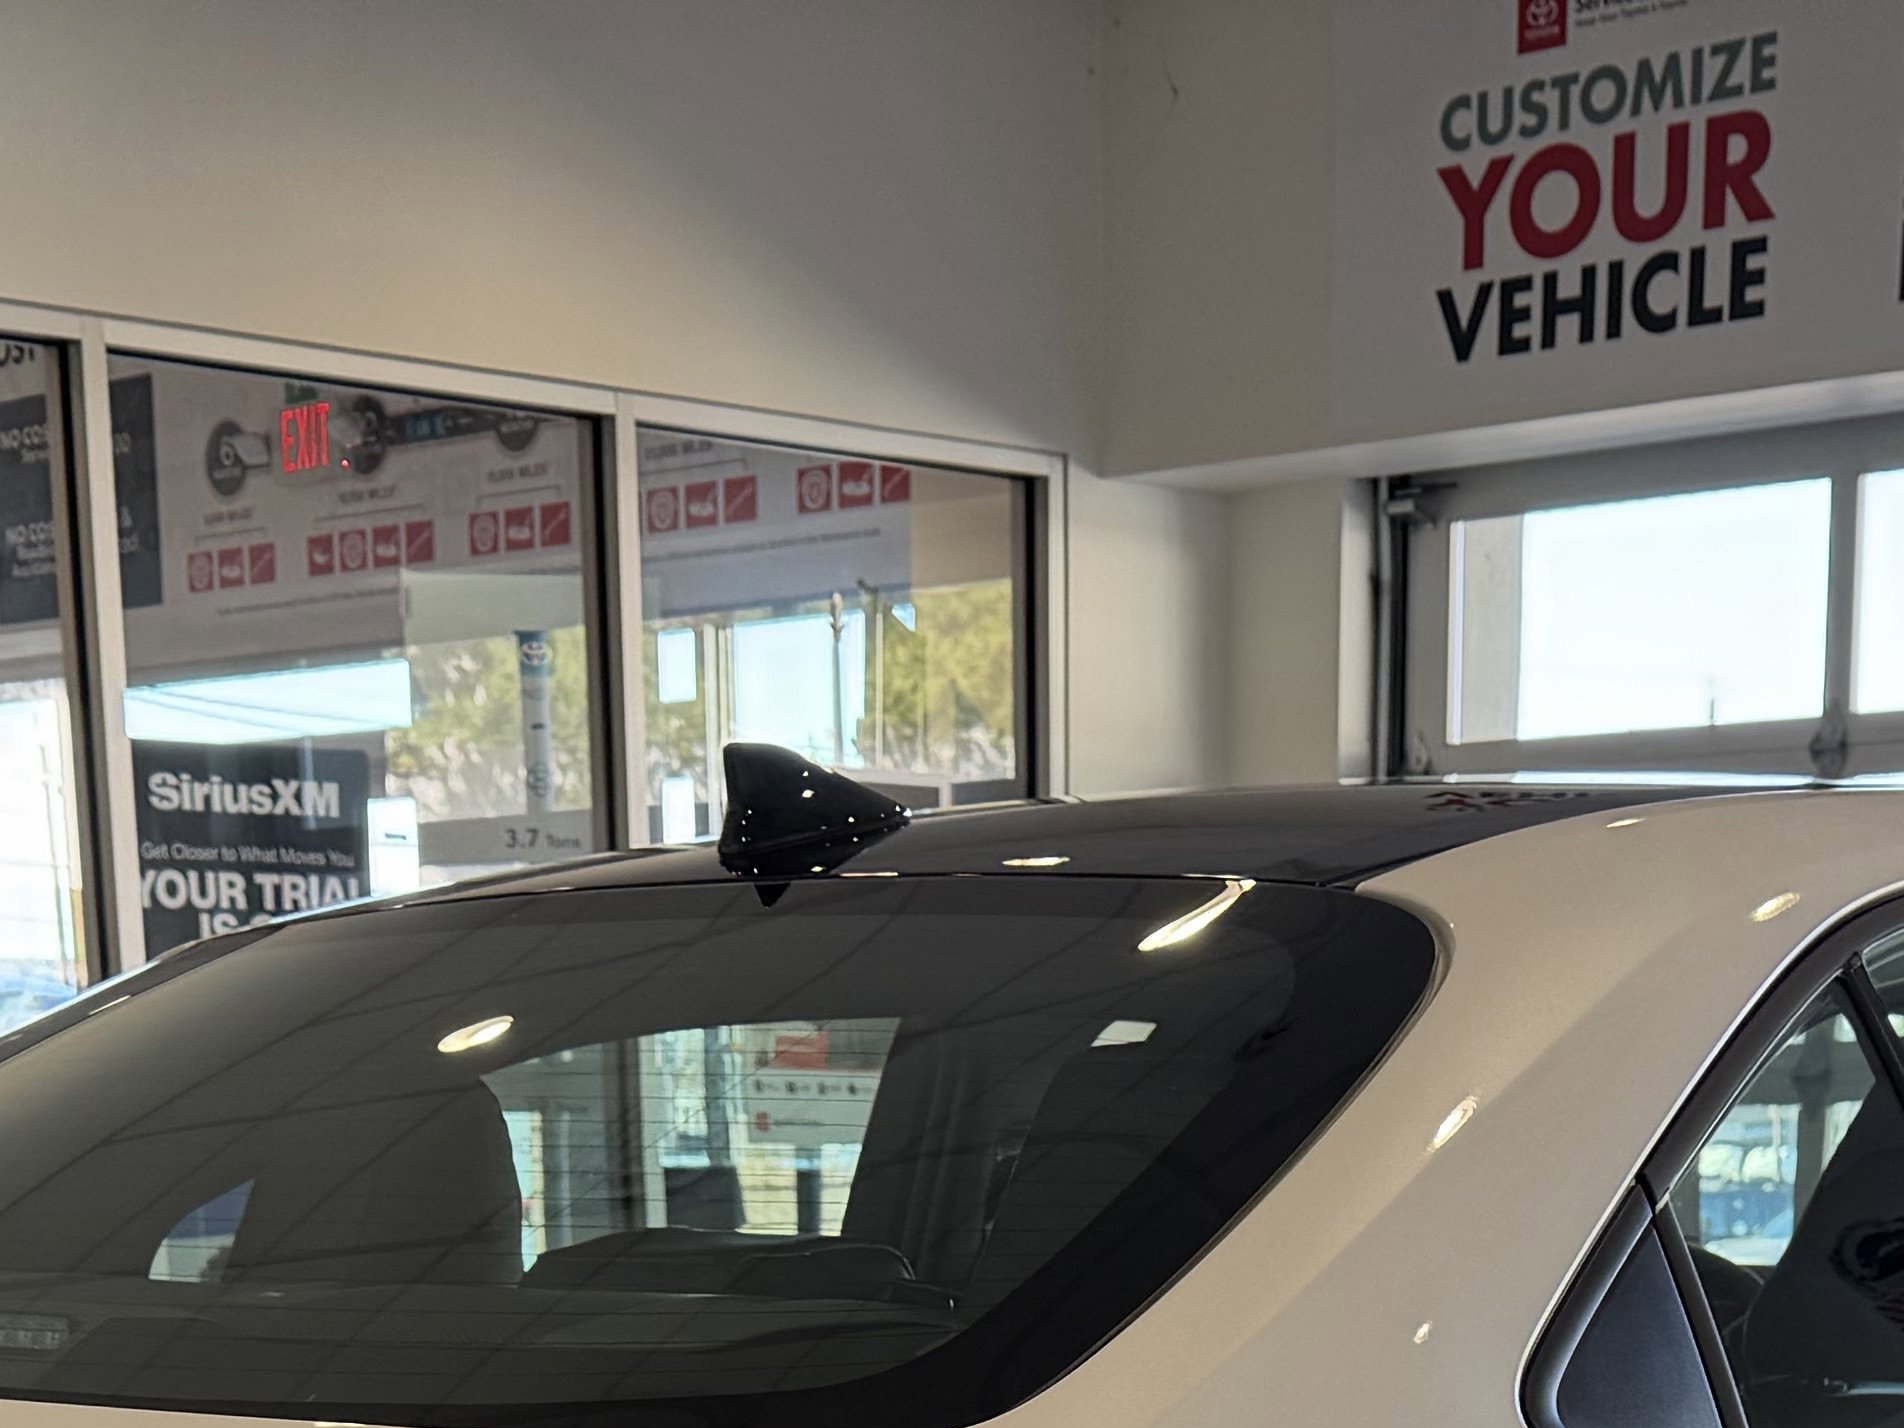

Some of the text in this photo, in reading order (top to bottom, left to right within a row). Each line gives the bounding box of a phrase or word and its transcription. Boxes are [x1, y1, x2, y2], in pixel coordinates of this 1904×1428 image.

[1439, 31, 1779, 152] CUSTOMIZE
[1436, 108, 1777, 273] YOUR
[1436, 234, 1770, 365] VEHICLE
[280, 402, 330, 473] EXIT
[147, 771, 341, 819] SiriusXM
[141, 841, 169, 860] Get
[171, 843, 219, 862] Closer
[221, 846, 237, 862] to
[238, 845, 278, 863] What
[280, 848, 326, 866] Moves
[140, 868, 248, 911] YOUR
